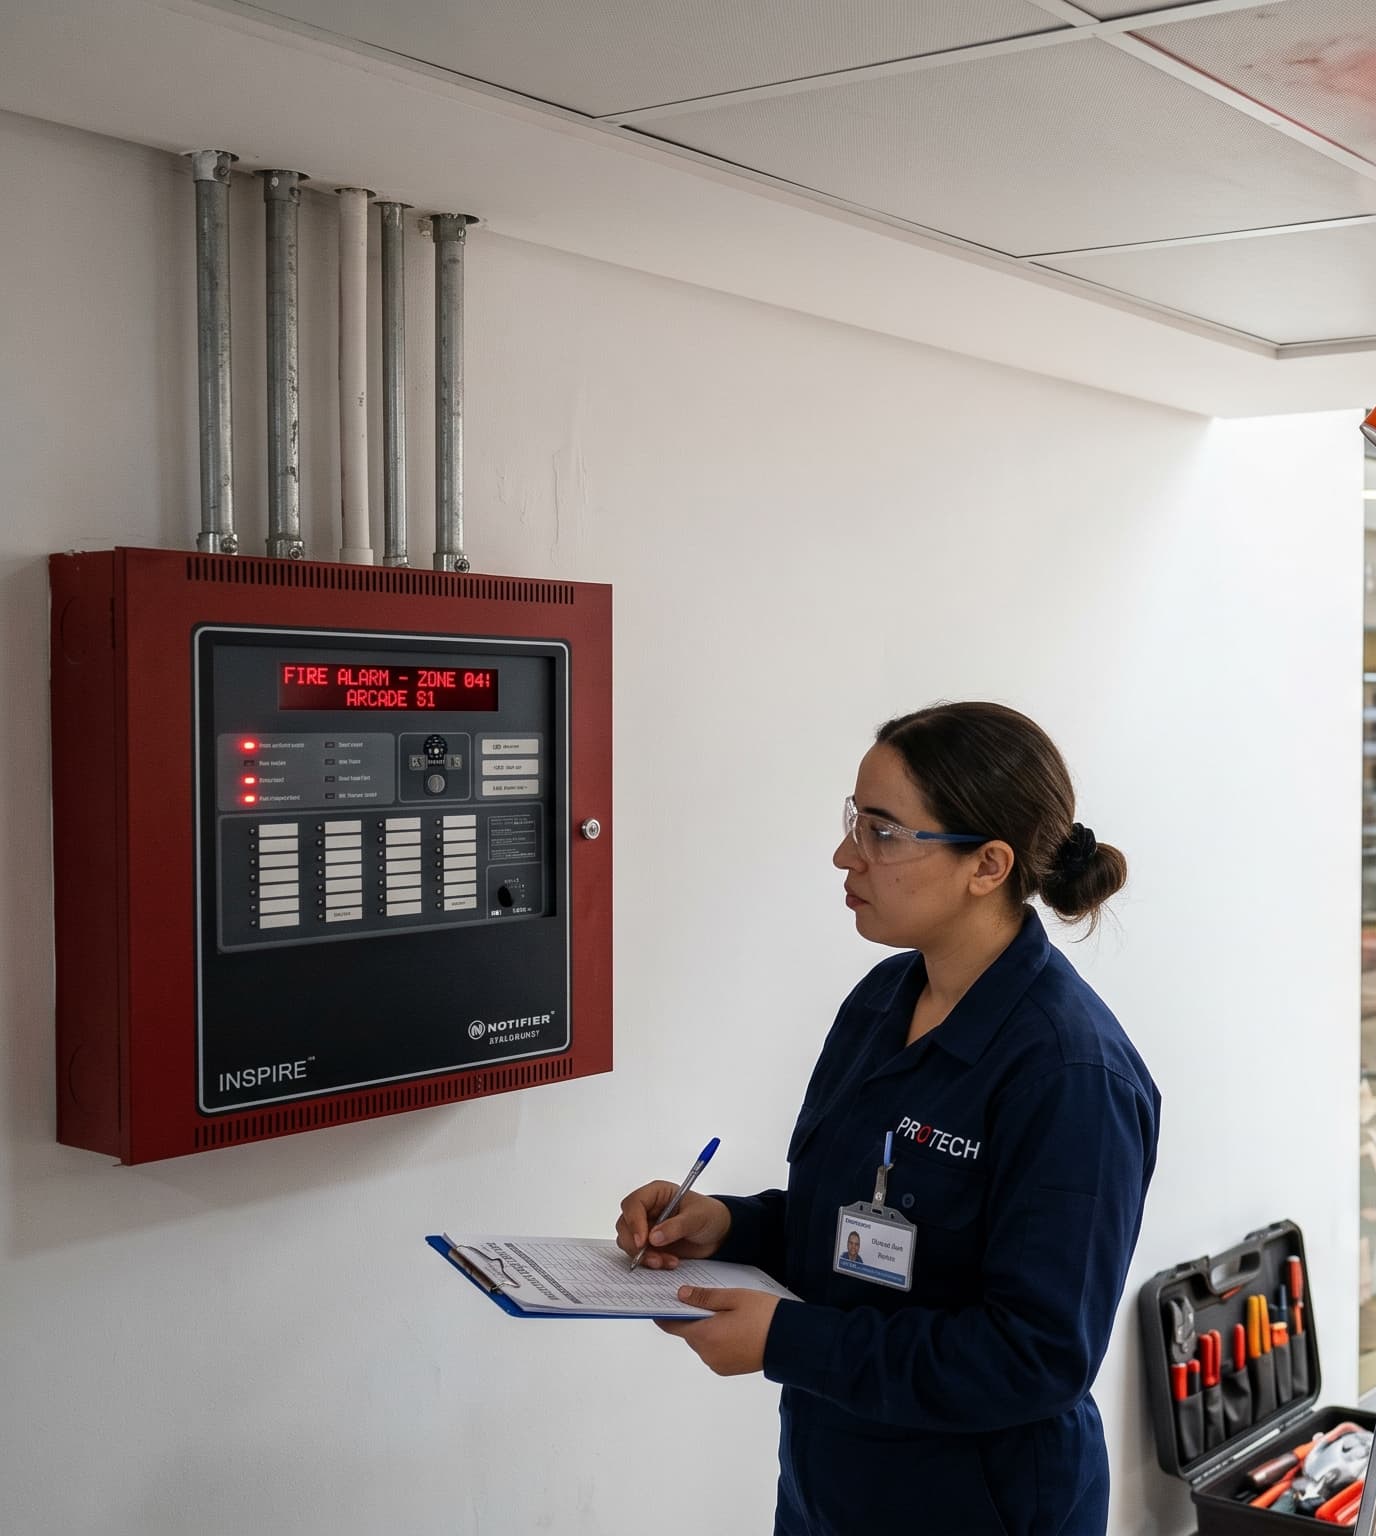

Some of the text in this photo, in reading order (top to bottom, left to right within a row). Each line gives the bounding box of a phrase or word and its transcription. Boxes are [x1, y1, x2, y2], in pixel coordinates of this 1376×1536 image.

[284, 666, 328, 685] FIRE
[338, 668, 389, 686] ALARM
[418, 670, 456, 688] ZONE
[346, 689, 436, 708] ARCADE S1
[487, 1014, 551, 1033] NOTIFIER
[219, 1060, 307, 1092] INSPIRE
[896, 1116, 981, 1160] PROTECH
